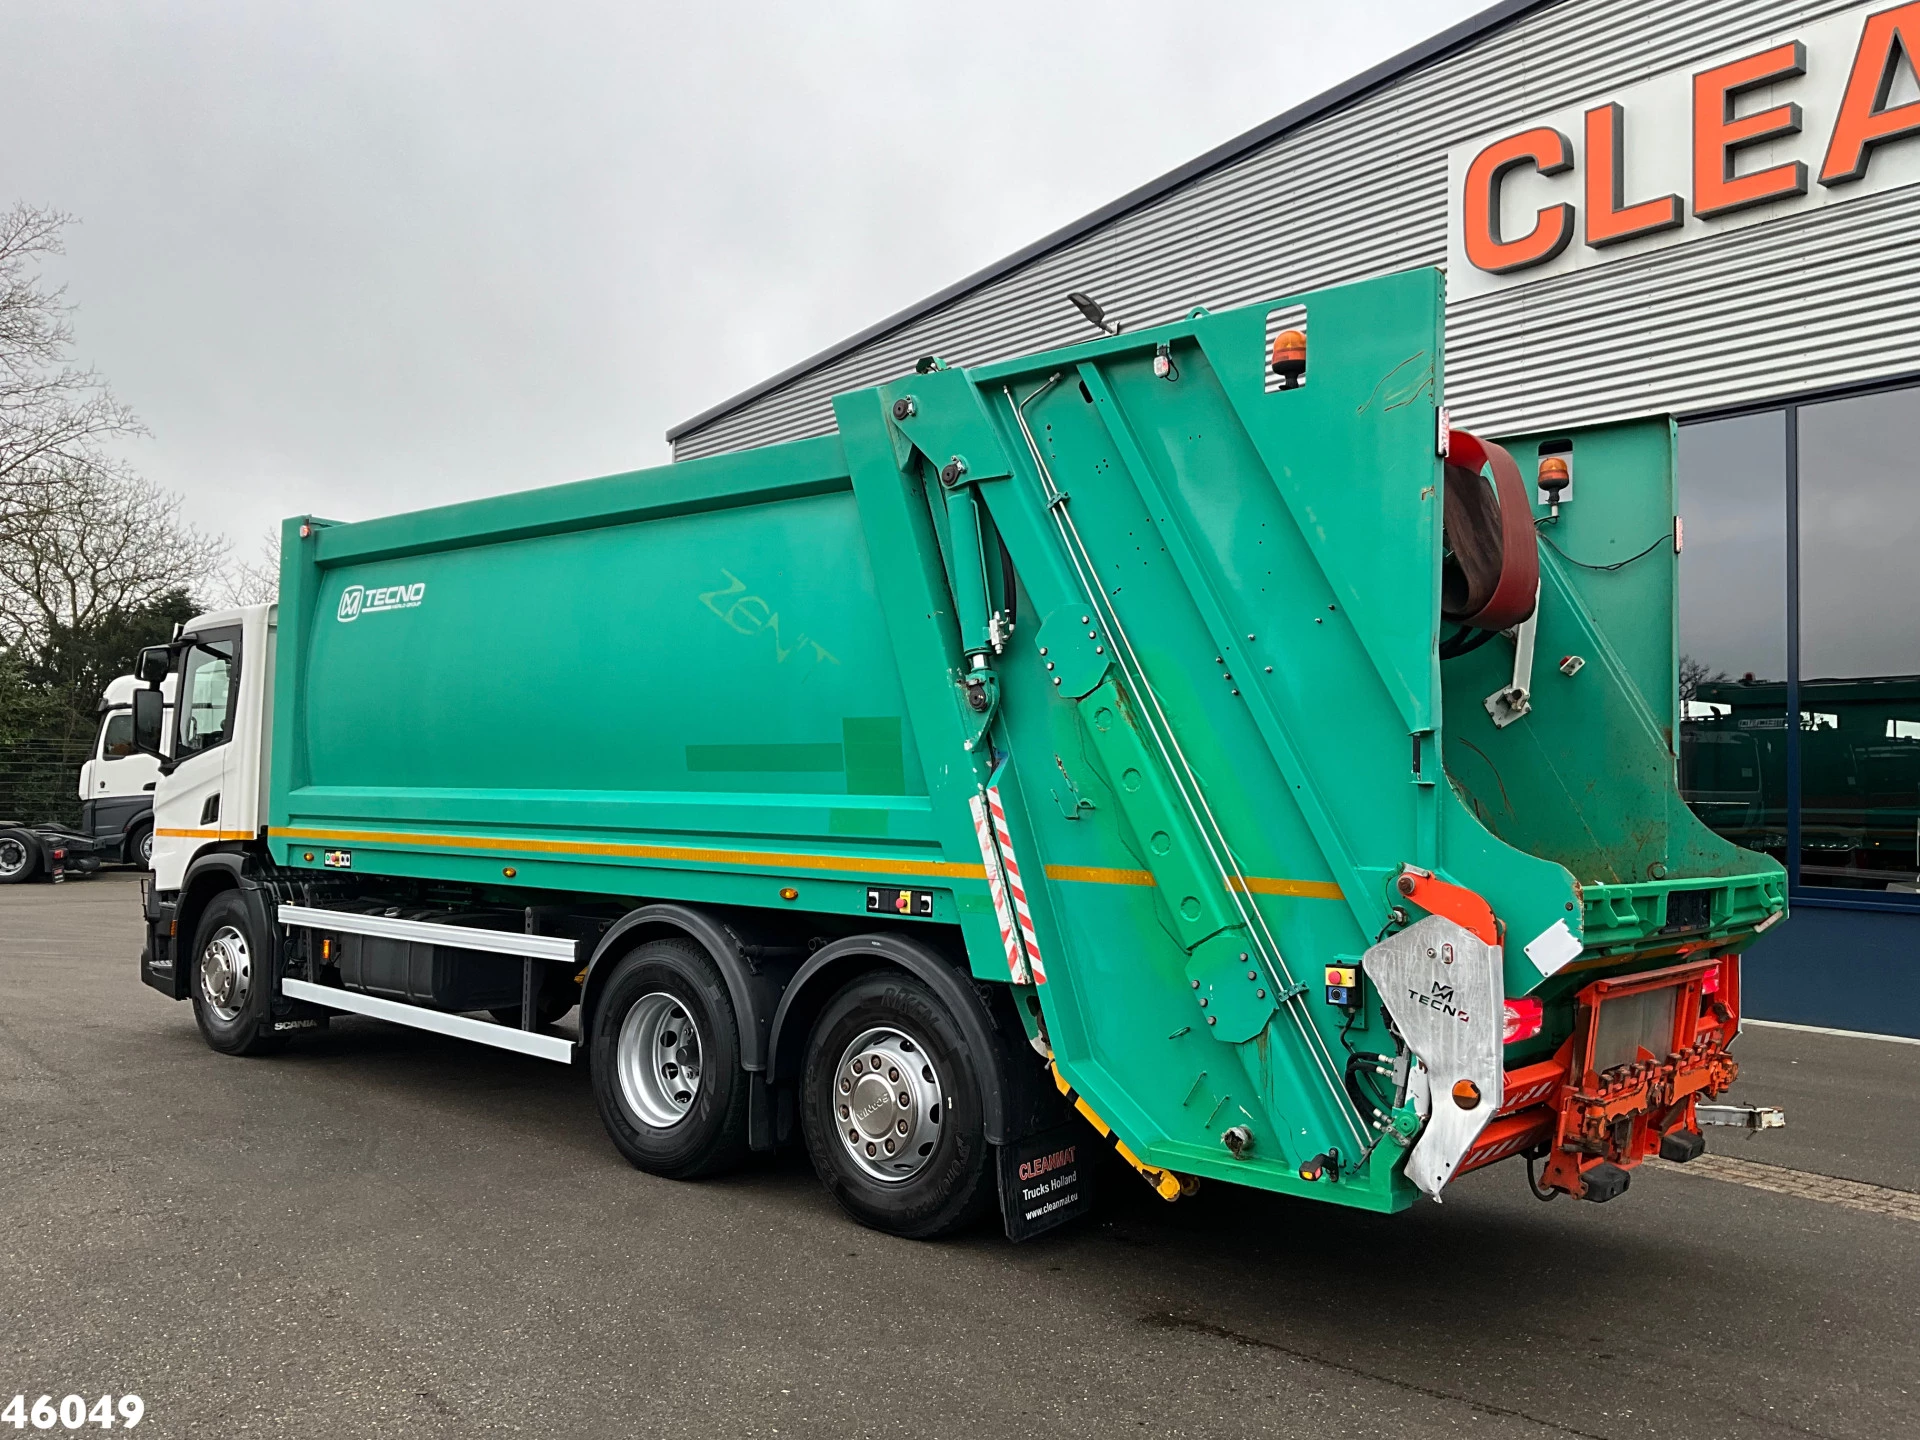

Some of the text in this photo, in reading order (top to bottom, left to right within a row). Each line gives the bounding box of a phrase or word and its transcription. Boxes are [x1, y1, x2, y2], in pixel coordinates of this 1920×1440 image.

[366, 583, 425, 607] TECNO
[1408, 989, 1469, 1022] TECNO
[274, 1019, 318, 1031] SCANIA
[1018, 1146, 1076, 1181] CLEANMAT
[1022, 1170, 1077, 1201] Trucks Holland
[1025, 1192, 1079, 1221] www.cleanmat.eu
